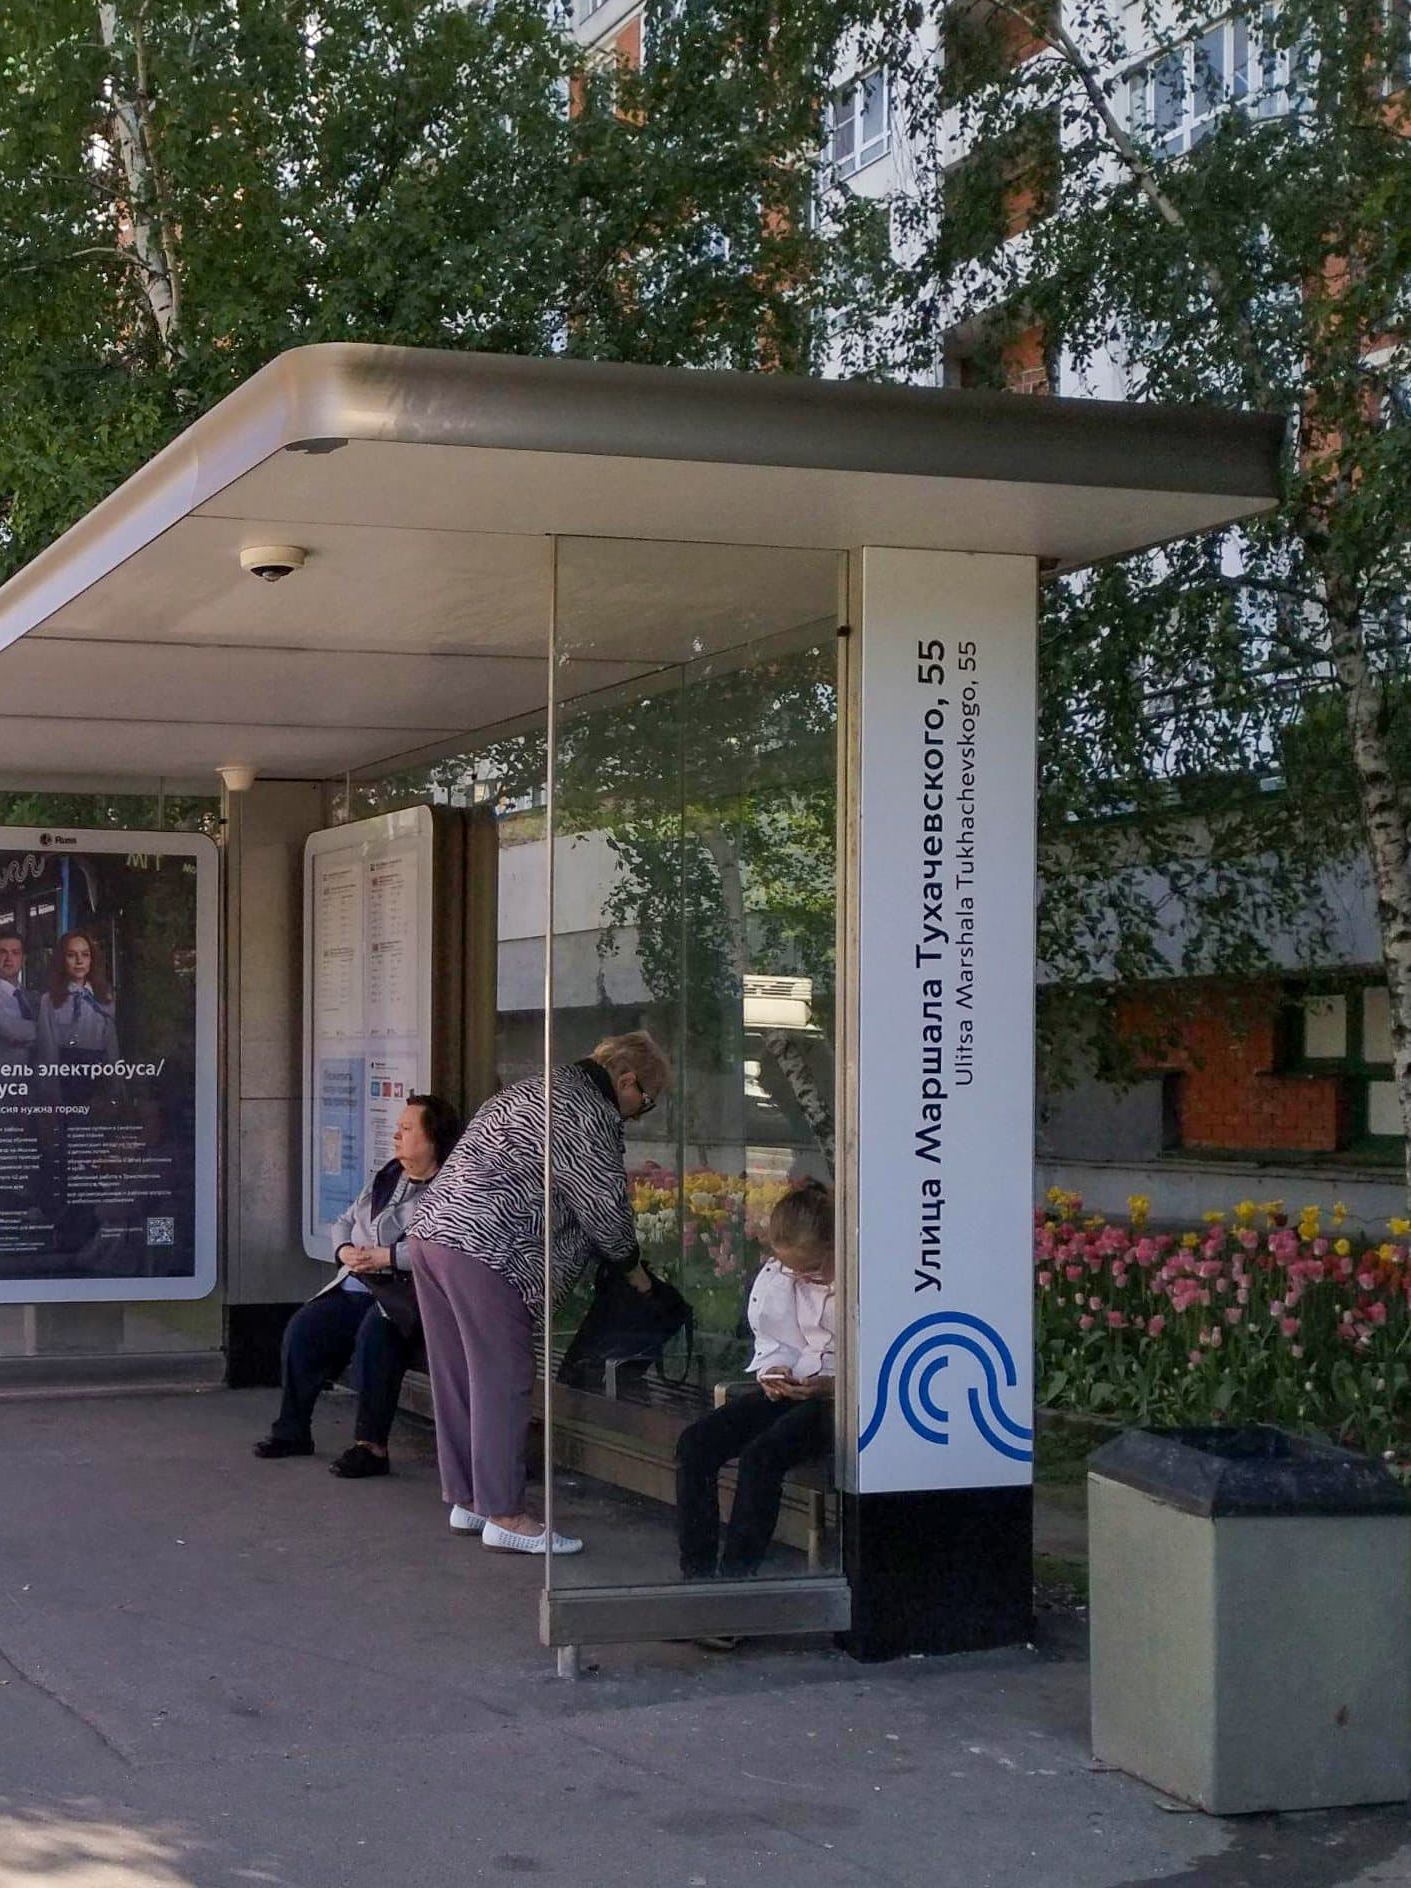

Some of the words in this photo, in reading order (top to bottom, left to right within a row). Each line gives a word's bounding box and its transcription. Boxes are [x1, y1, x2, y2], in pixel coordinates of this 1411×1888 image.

[917, 639, 946, 686] 55
[958, 640, 977, 672] 55
[955, 680, 981, 891] Tukhachevskogo,
[915, 697, 950, 969] Тухачевского,
[954, 897, 975, 1010] Marshala
[38, 1058, 166, 1080] электробуса/
[915, 979, 949, 1164] Маршала
[954, 1019, 974, 1086] Ulitsa
[20, 1105, 53, 1116] нужна
[54, 1105, 91, 1116] городу
[915, 1179, 946, 1294] Улица
